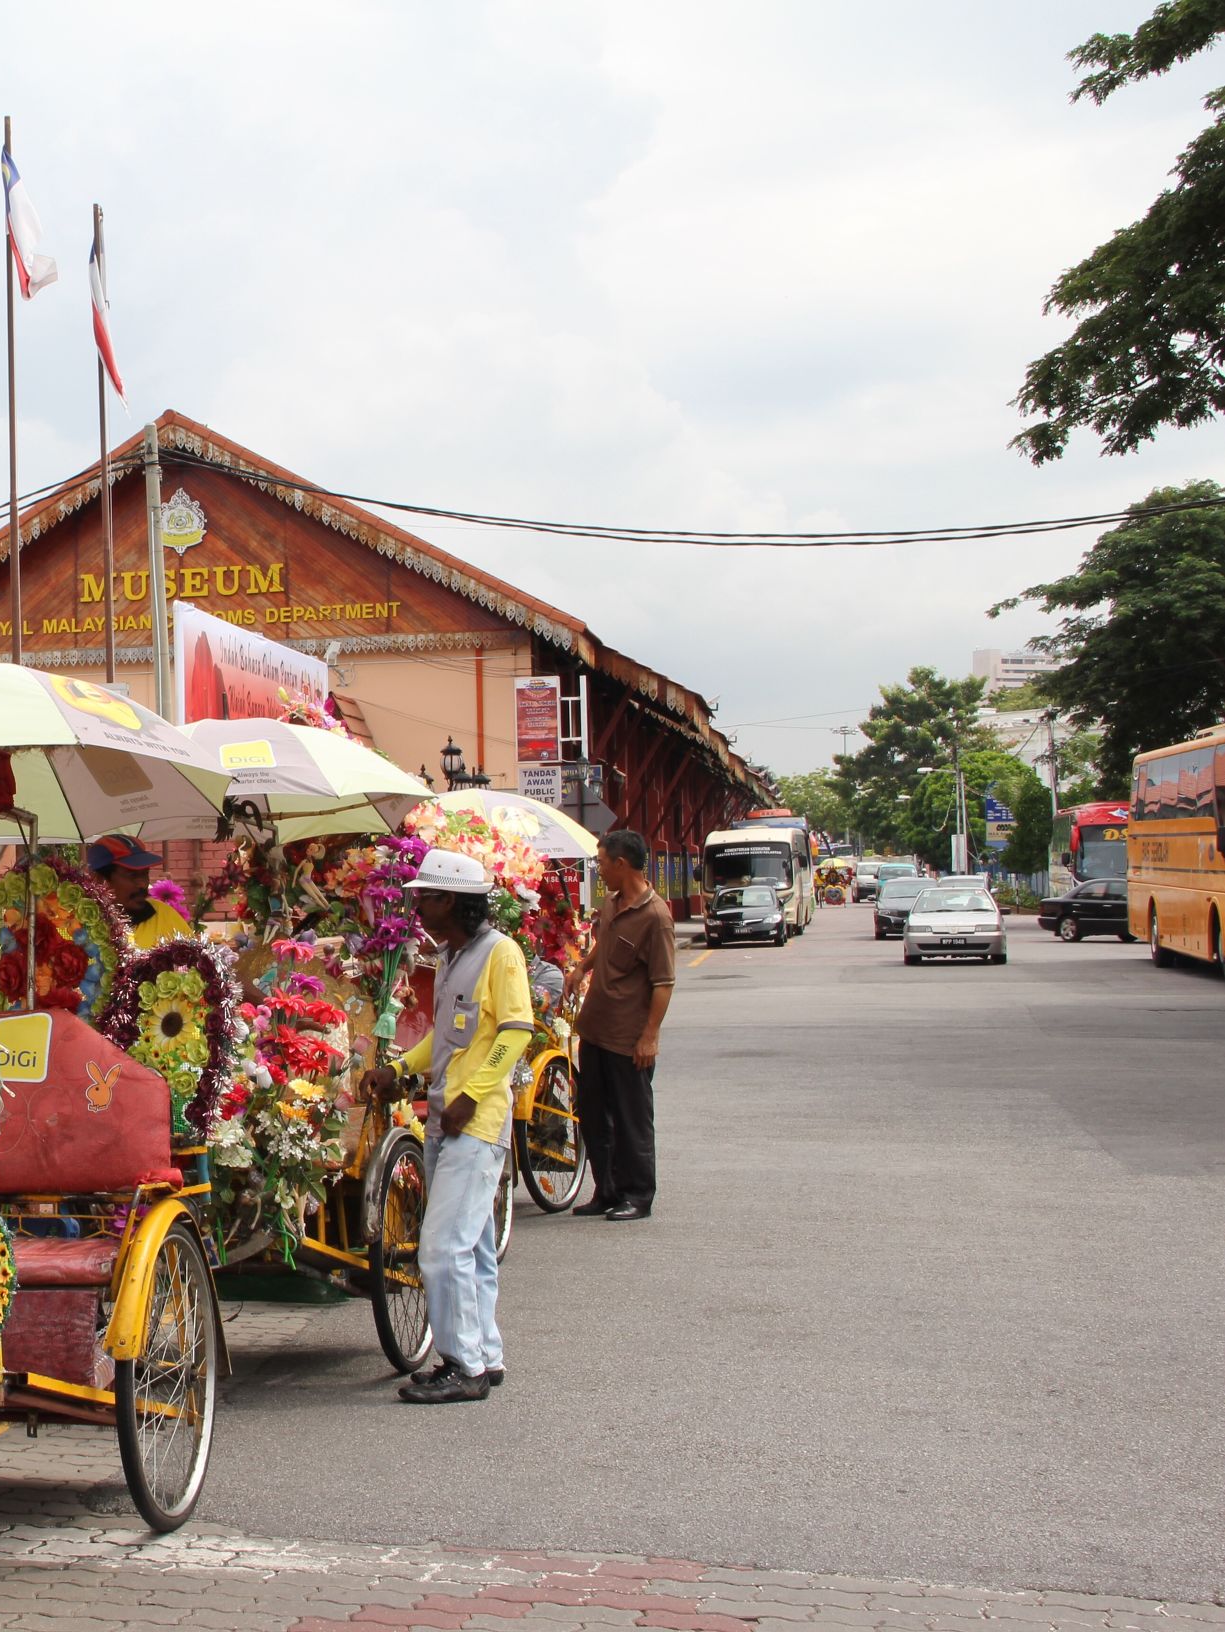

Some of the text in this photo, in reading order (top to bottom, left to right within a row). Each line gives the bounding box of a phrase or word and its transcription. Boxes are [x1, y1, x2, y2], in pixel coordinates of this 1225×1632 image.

[265, 602, 400, 624] DEPARTMENT
[523, 769, 556, 777] TANDAS
[525, 788, 555, 796] PUBLIC
[657, 855, 665, 894] MUSEUM
[487, 1043, 509, 1067] YAMAHA
